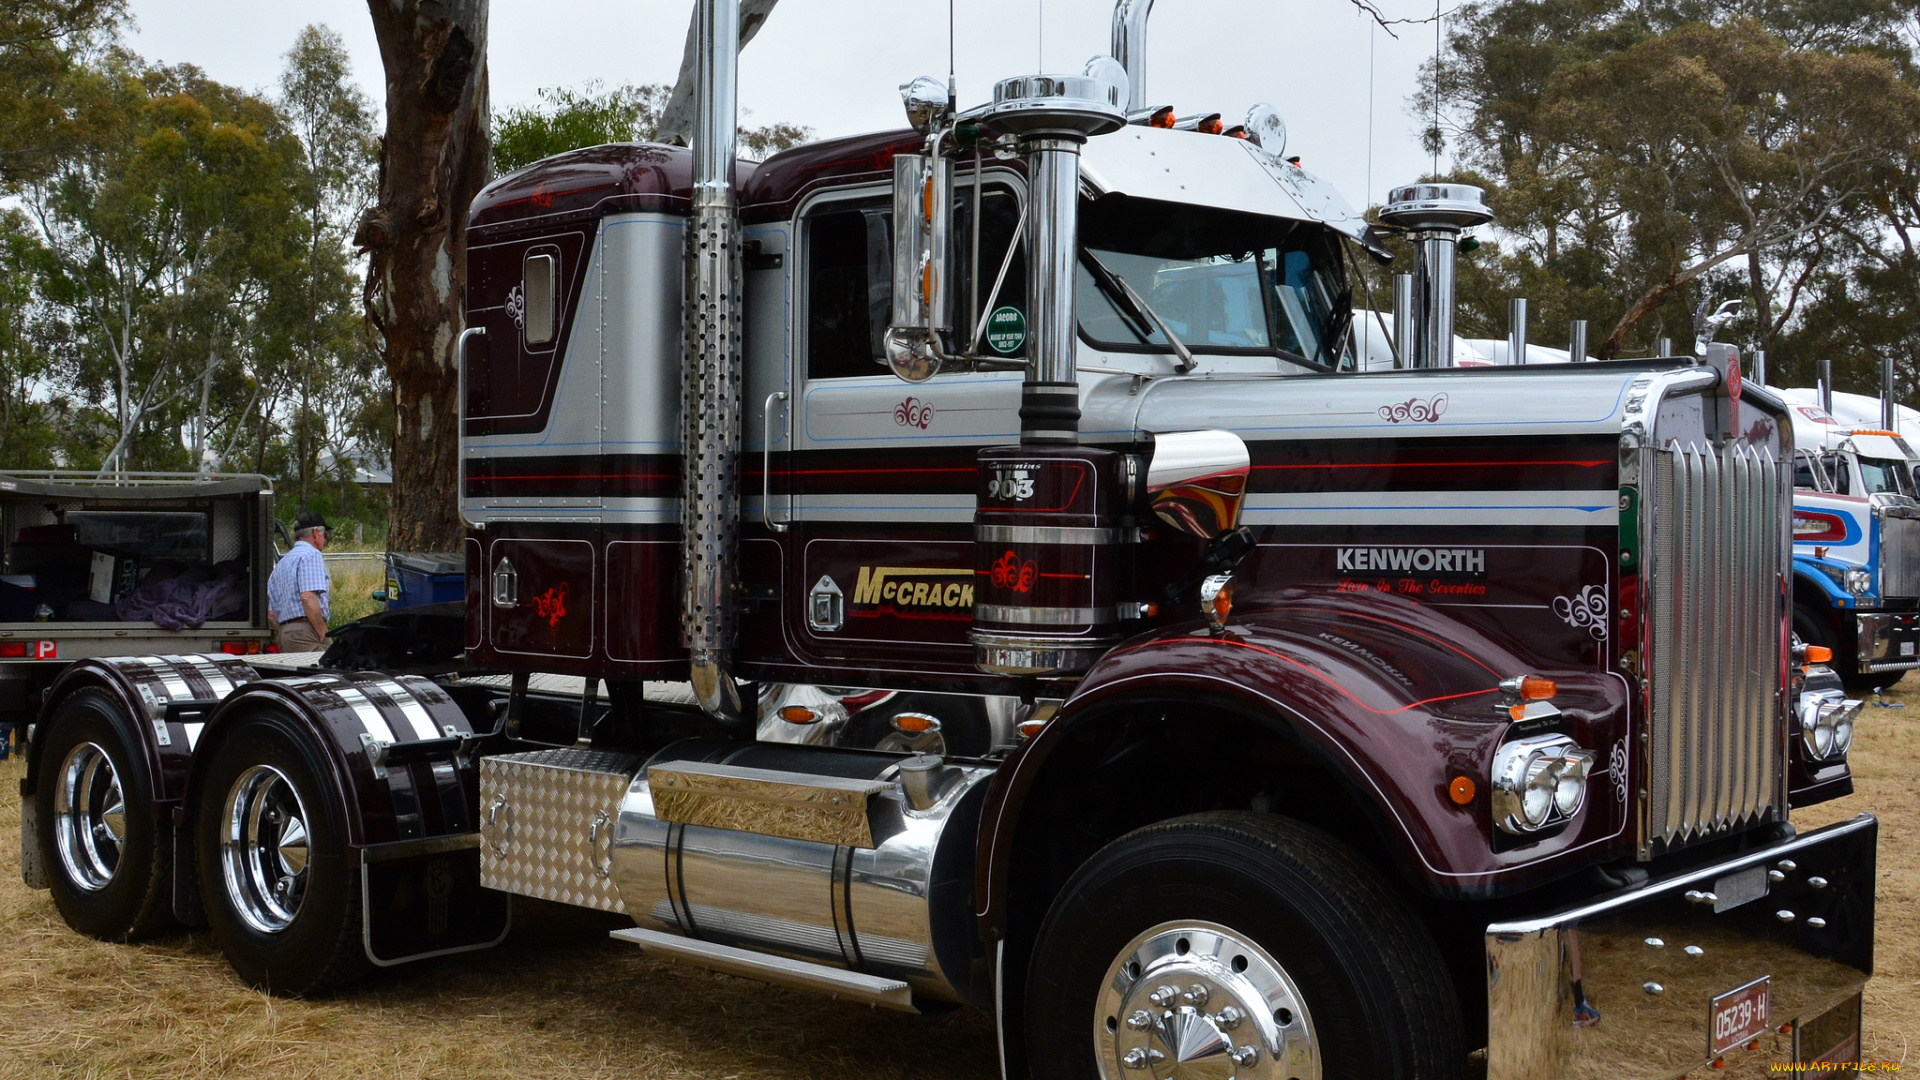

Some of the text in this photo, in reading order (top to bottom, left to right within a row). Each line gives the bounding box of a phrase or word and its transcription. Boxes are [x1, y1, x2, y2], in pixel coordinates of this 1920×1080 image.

[995, 312, 1017, 322] JACOBS
[988, 461, 1041, 470] Cummins
[988, 480, 1034, 498] 903
[1337, 548, 1485, 572] KENWORTH
[1336, 578, 1369, 592] Livin
[1398, 579, 1423, 593] The
[1428, 579, 1486, 594] Seventies
[40, 641, 54, 658] P
